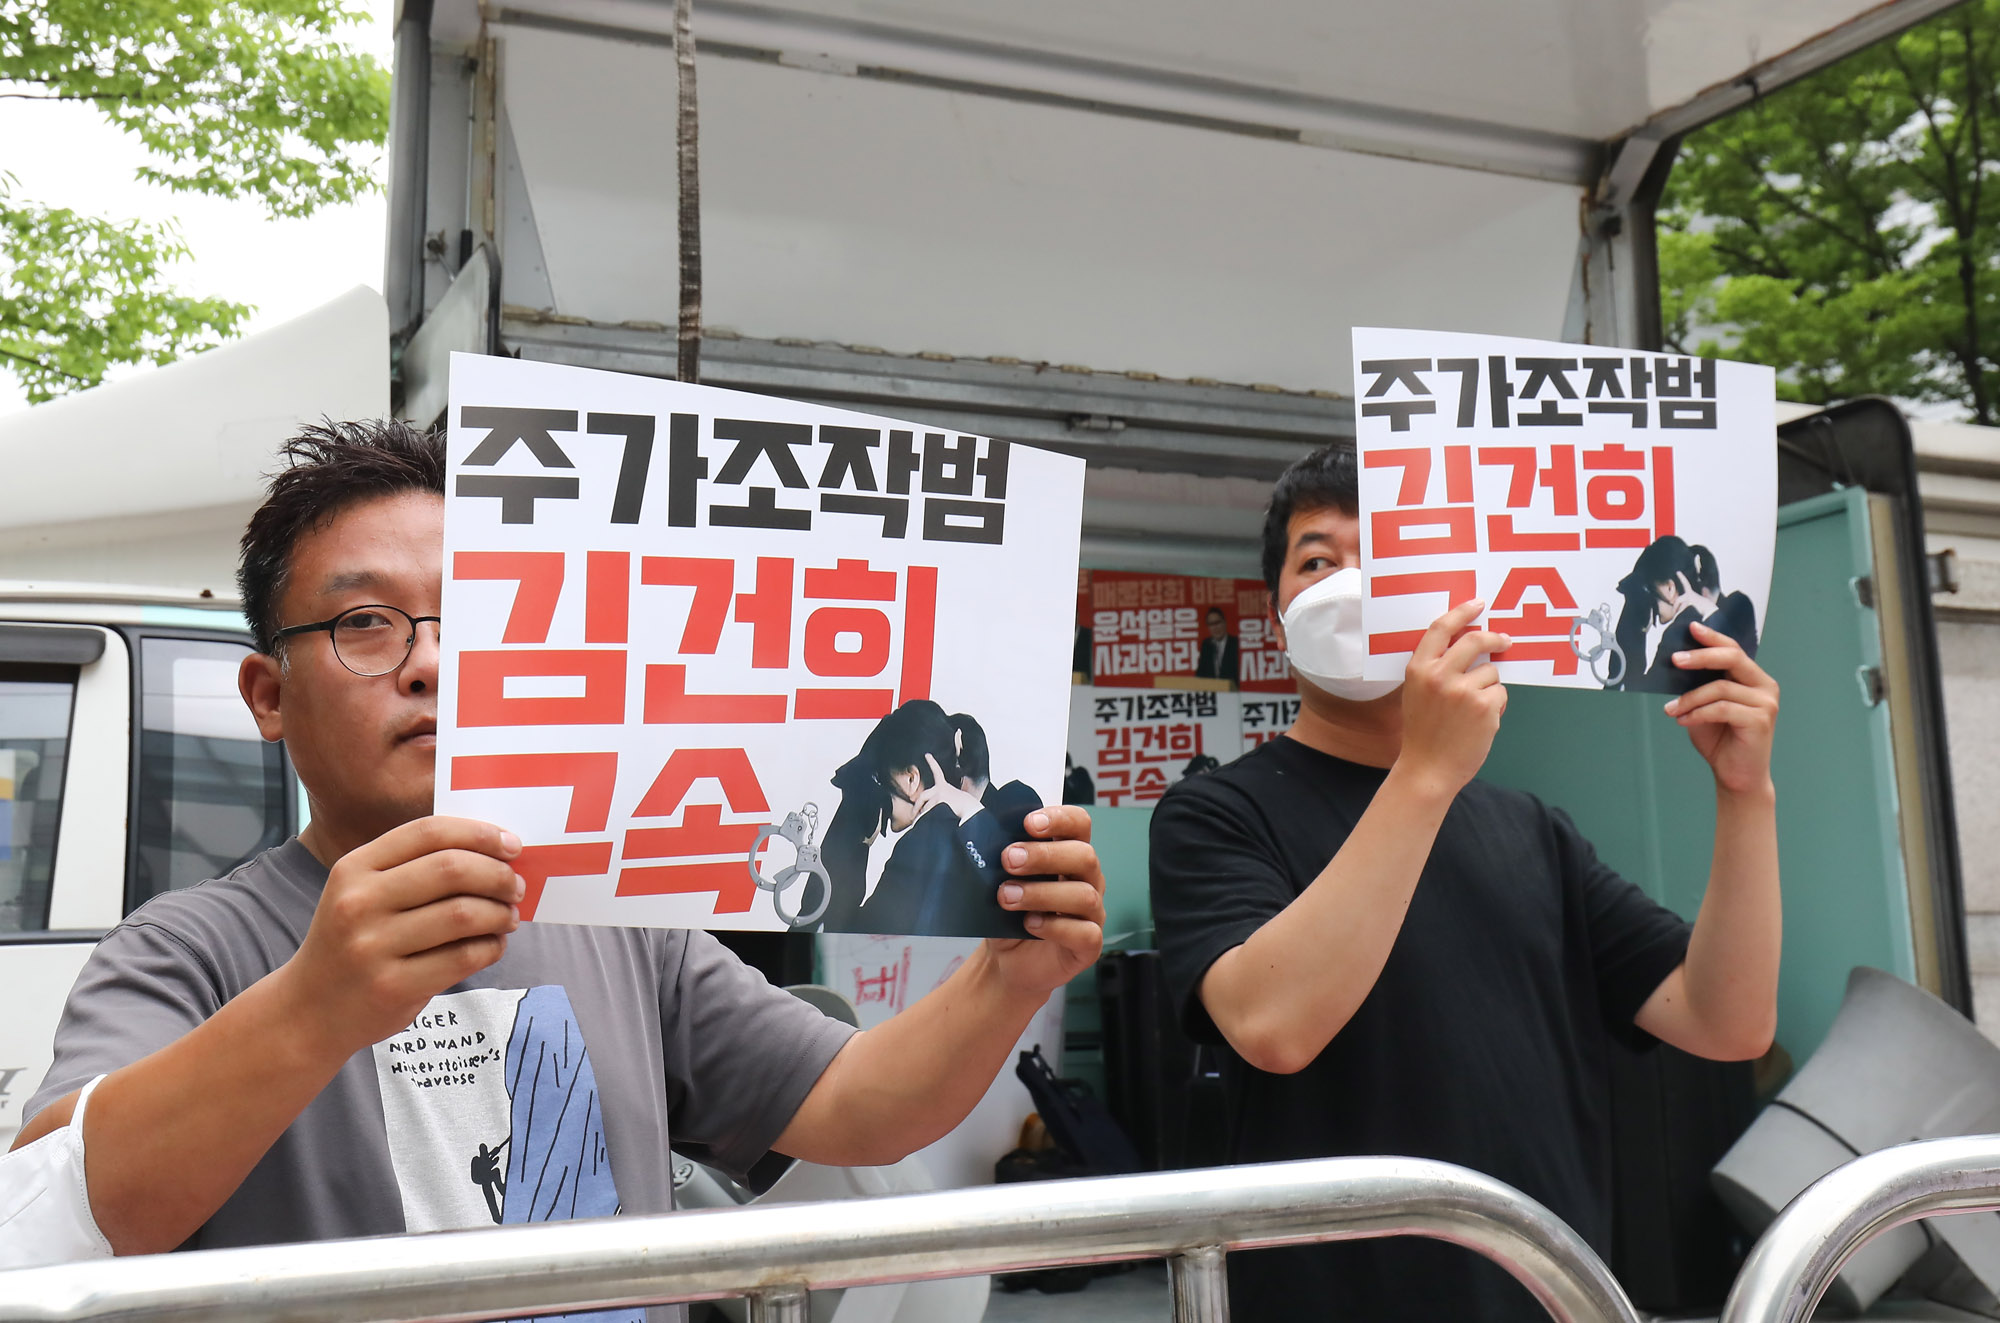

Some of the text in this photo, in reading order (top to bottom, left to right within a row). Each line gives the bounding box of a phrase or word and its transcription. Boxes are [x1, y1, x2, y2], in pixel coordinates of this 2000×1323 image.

[1361, 355, 1717, 432] 주가조작범
[456, 405, 1011, 545] 주가조작범
[1364, 443, 1676, 560] 김건희
[452, 550, 939, 728] 김건희
[1093, 607, 1199, 643] 윤석열은
[1369, 567, 1582, 676] 구속
[1094, 640, 1200, 676] 사과하라
[1095, 691, 1218, 723] 주가조작범
[1095, 723, 1204, 767] 김건희
[1096, 767, 1168, 808] 구속
[451, 748, 772, 922] 구속
[402, 1010, 458, 1032] IGER
[433, 1031, 485, 1050] WAND
[411, 1073, 475, 1088] raverse
